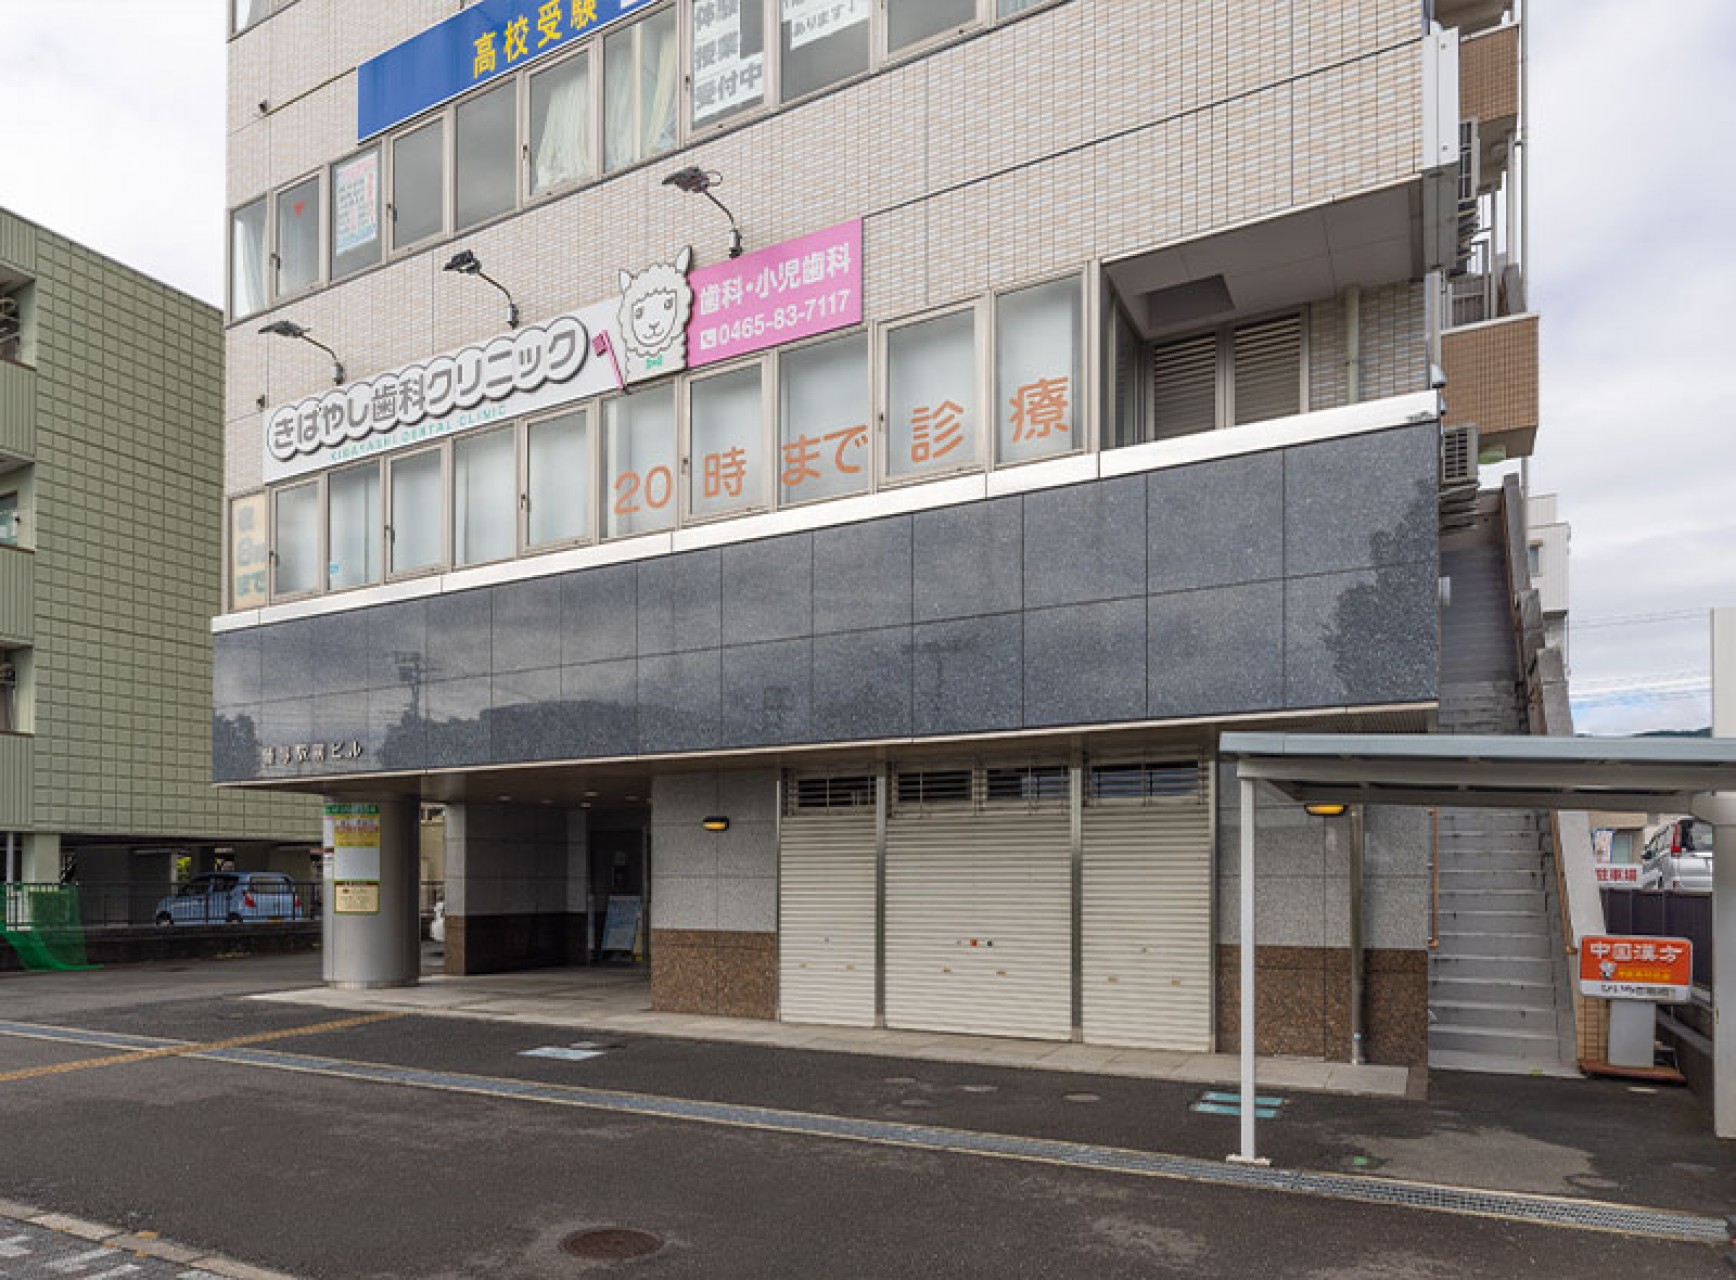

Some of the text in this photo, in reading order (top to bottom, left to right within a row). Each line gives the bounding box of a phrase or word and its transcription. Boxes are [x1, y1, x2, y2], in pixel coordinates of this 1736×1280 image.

[696, 62, 763, 110] 受付中
[700, 243, 851, 315] 歯科・小児歯科
[719, 290, 851, 344] 0465-83-7117
[274, 328, 577, 450] きばやし歯科クリニック
[402, 420, 452, 443] DENTAL
[459, 405, 507, 426] CLINIC
[1595, 867, 1638, 882] 駐車場
[1589, 940, 1684, 964] 中国漢方
